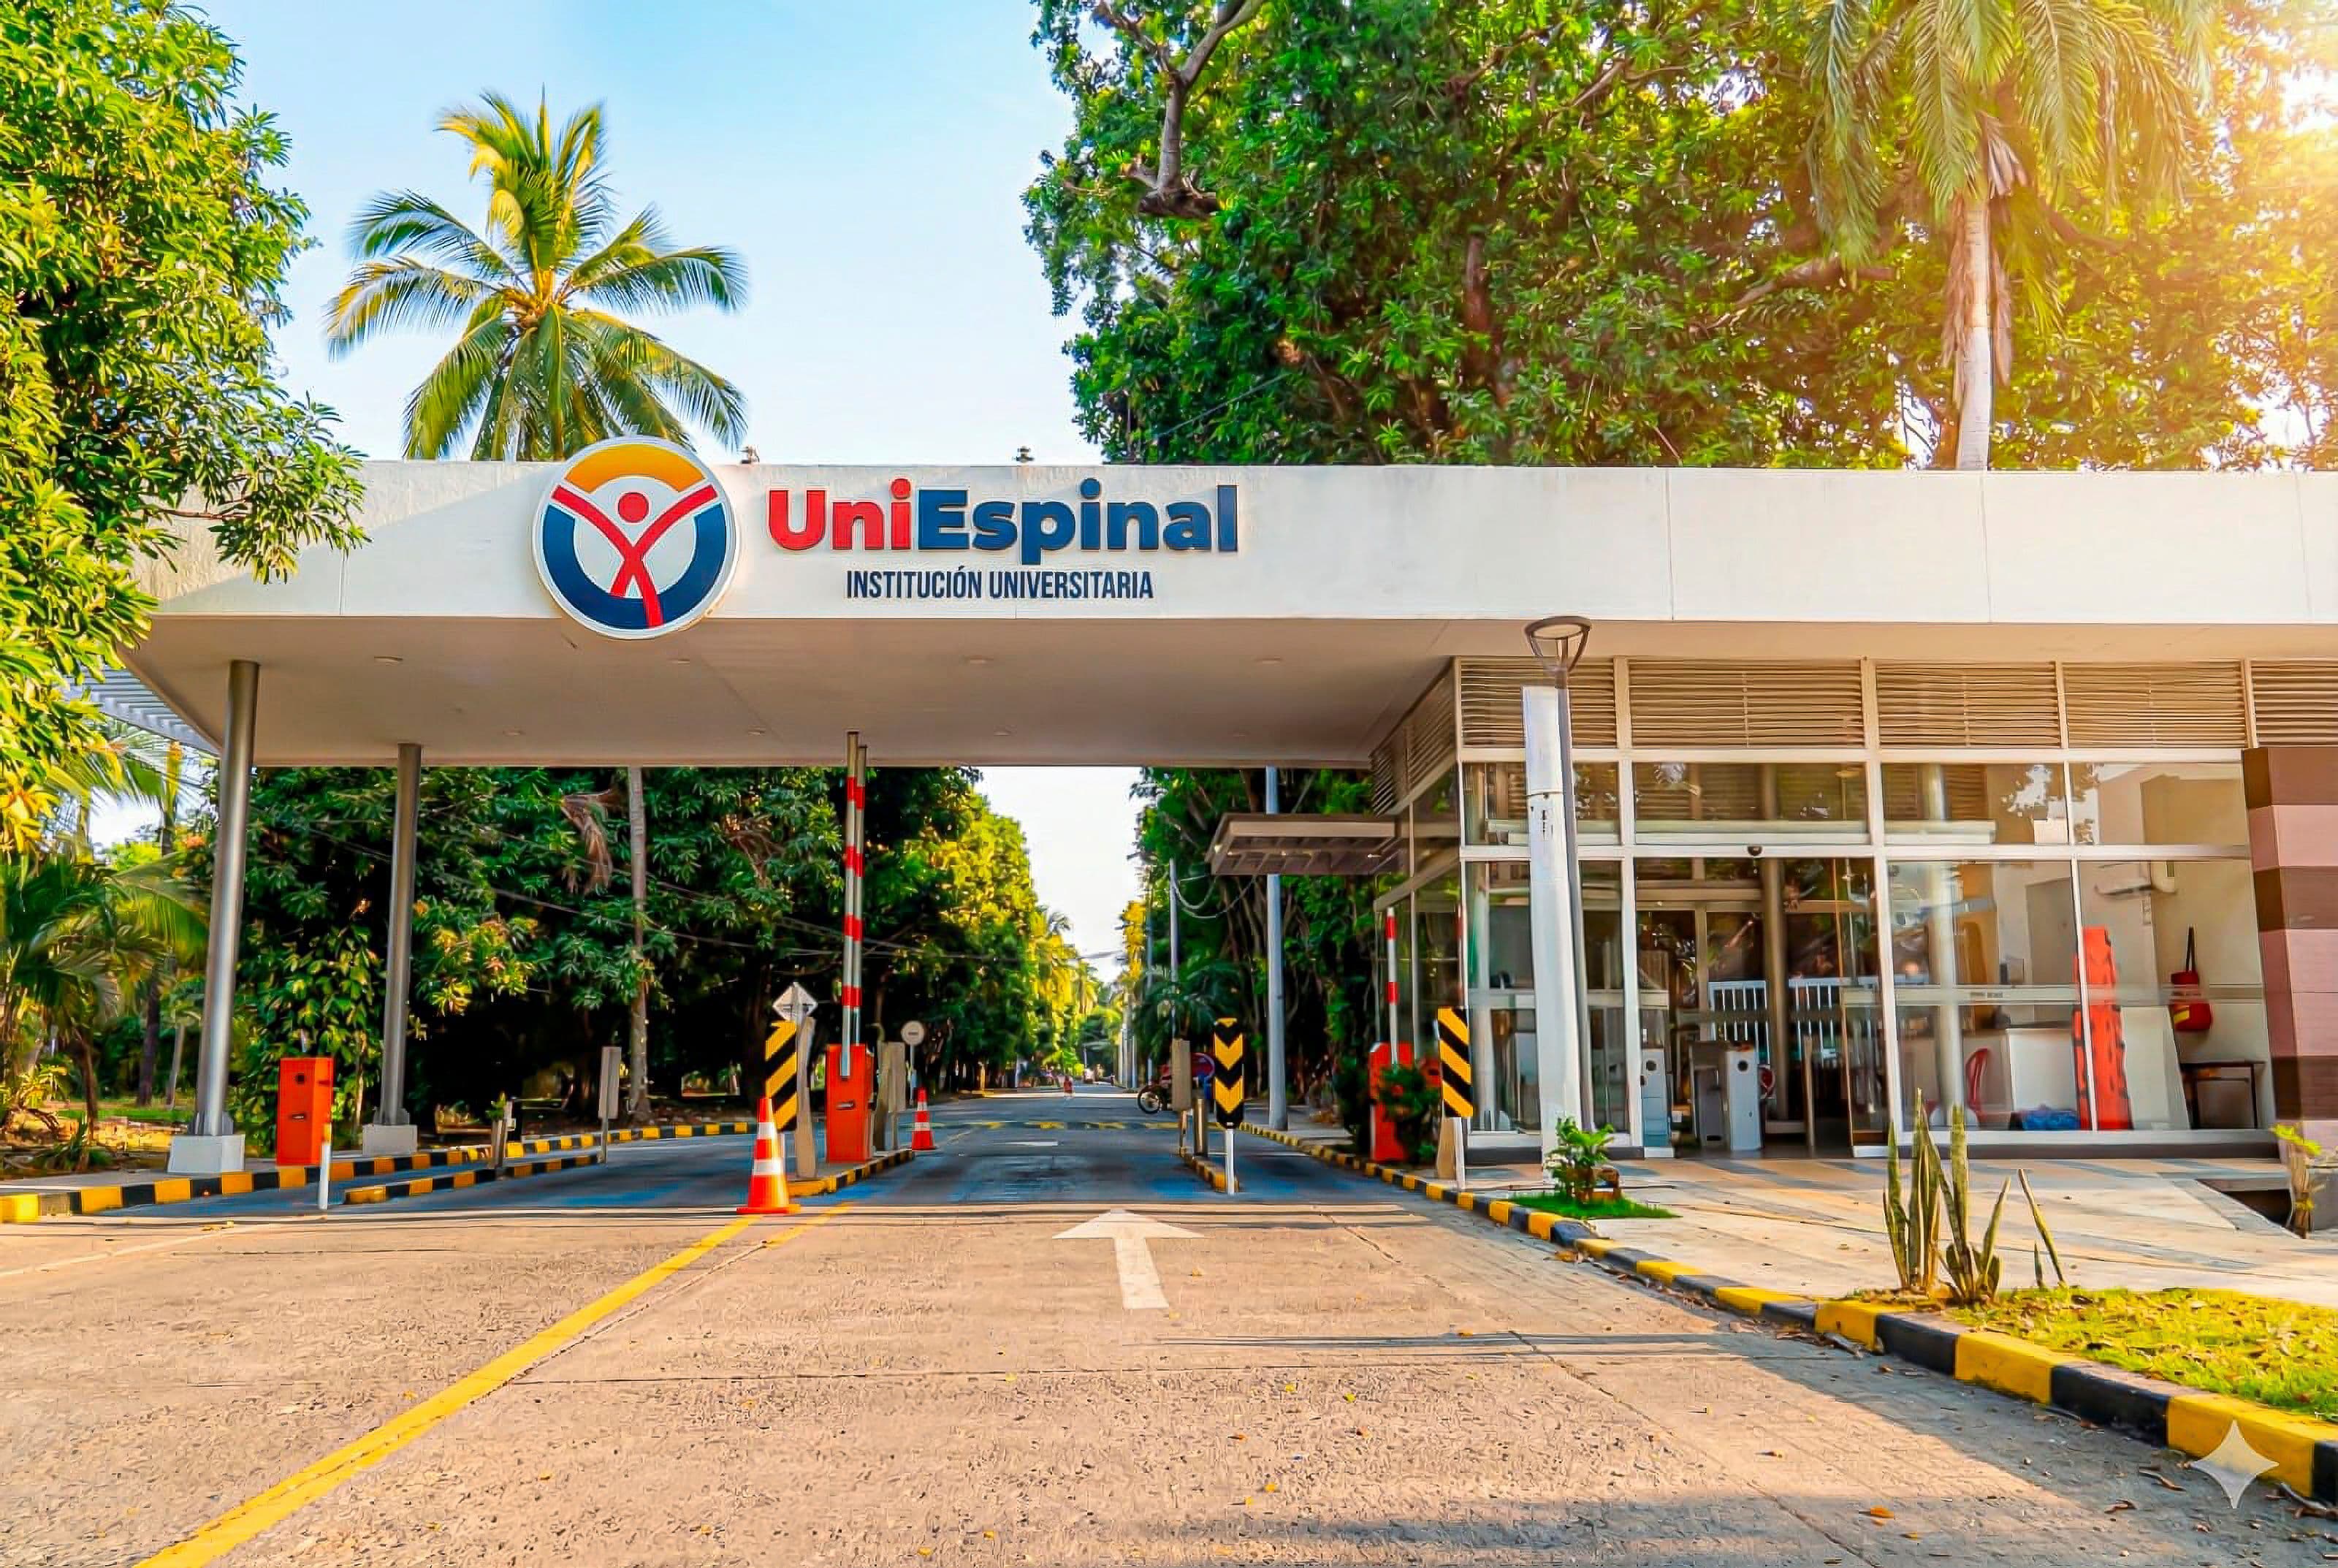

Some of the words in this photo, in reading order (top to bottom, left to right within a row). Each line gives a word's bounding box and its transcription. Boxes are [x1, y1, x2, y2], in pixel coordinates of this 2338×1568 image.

[768, 477, 1239, 566] UniEspinal
[847, 565, 983, 599] INSTITUCIÓN
[989, 571, 1154, 599] UNIVERSITARIA
